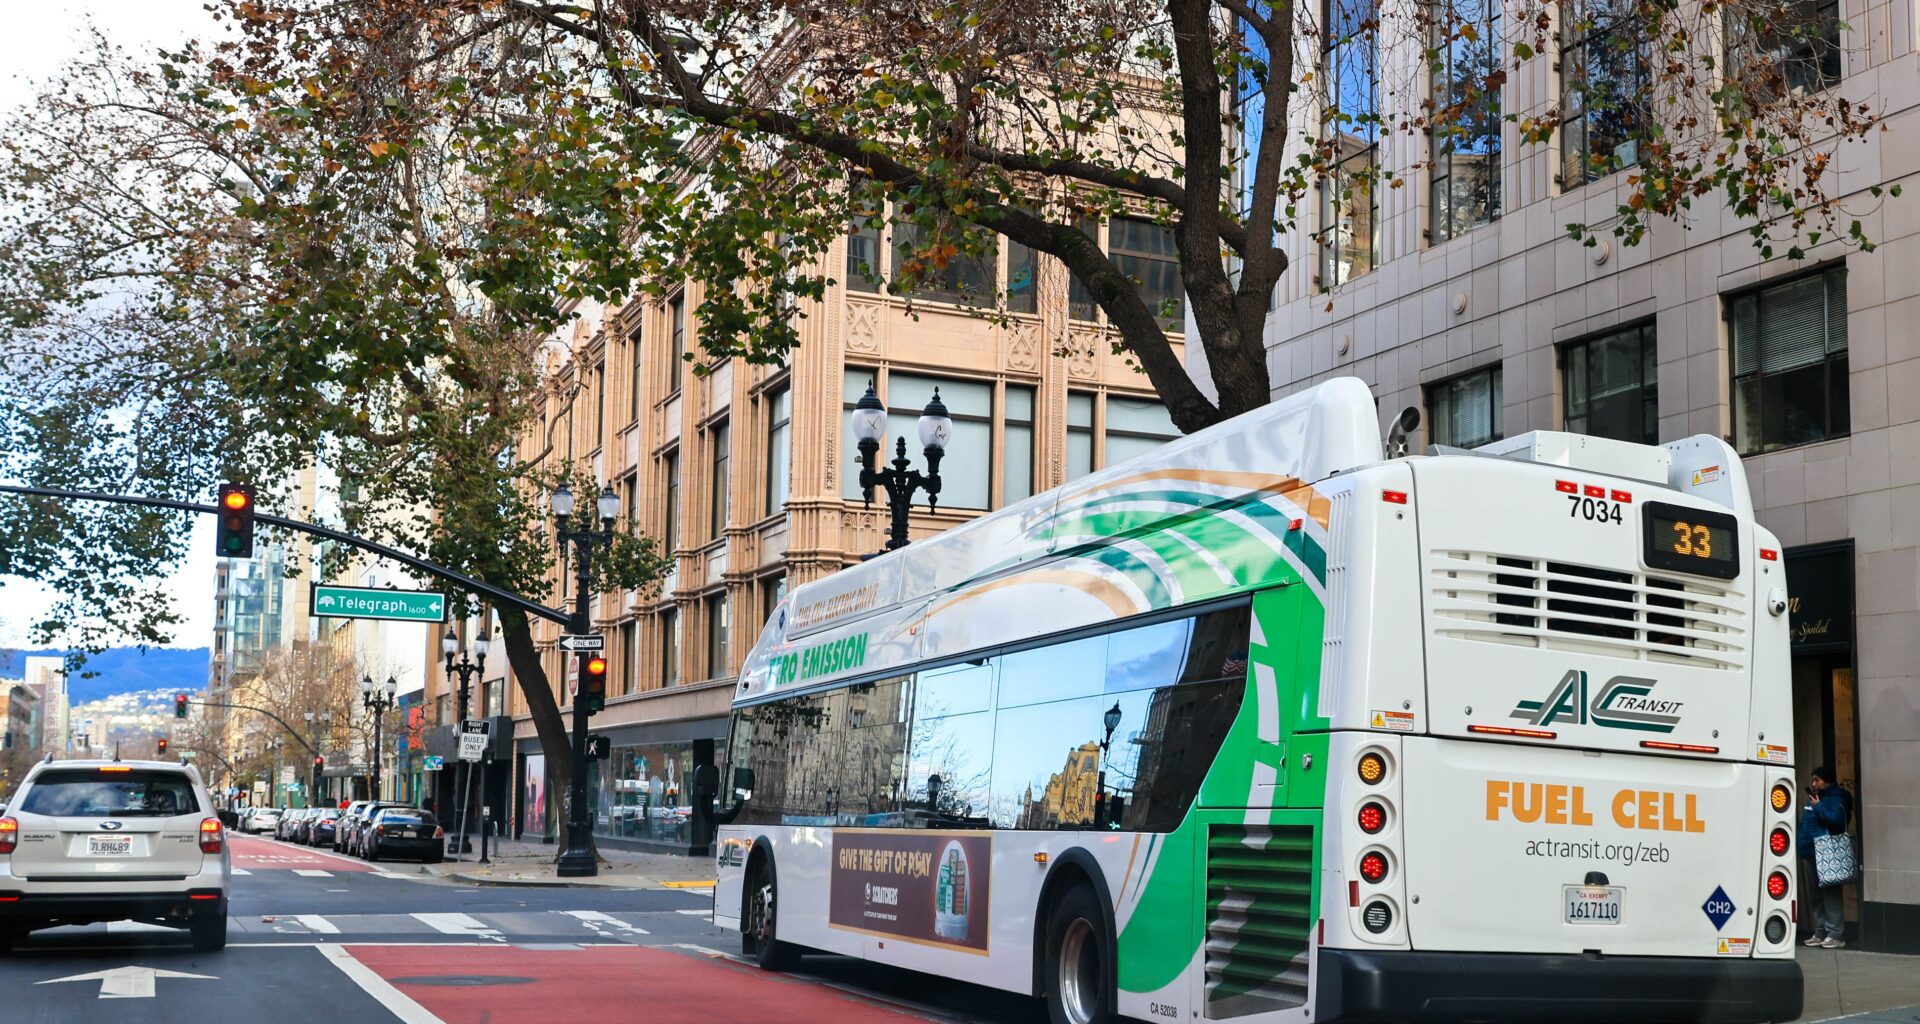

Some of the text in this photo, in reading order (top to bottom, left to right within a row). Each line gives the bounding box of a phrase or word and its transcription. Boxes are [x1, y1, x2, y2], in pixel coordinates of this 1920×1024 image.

[1568, 496, 1623, 525] 7034
[1674, 521, 1711, 558] 33
[338, 595, 426, 614] Telegraph 1600
[573, 640, 601, 648] ONE WAY
[801, 632, 868, 681] EMISSION
[1617, 695, 1684, 715] TRANSIT
[463, 735, 485, 744] BUSES
[464, 743, 482, 751] ONLY
[1486, 780, 1706, 833] FUEL CELL
[90, 842, 130, 852] 7LRH489
[1525, 838, 1670, 866] actransit.org/zeb
[840, 848, 857, 870] GIVE
[858, 849, 873, 872] THE
[874, 850, 894, 873] GIFT
[895, 851, 907, 875] OF
[871, 885, 899, 906] SCRATCHERS
[1570, 901, 1618, 919] 1617110
[1707, 901, 1731, 914] CH2
[1150, 1002, 1159, 1015] CA
